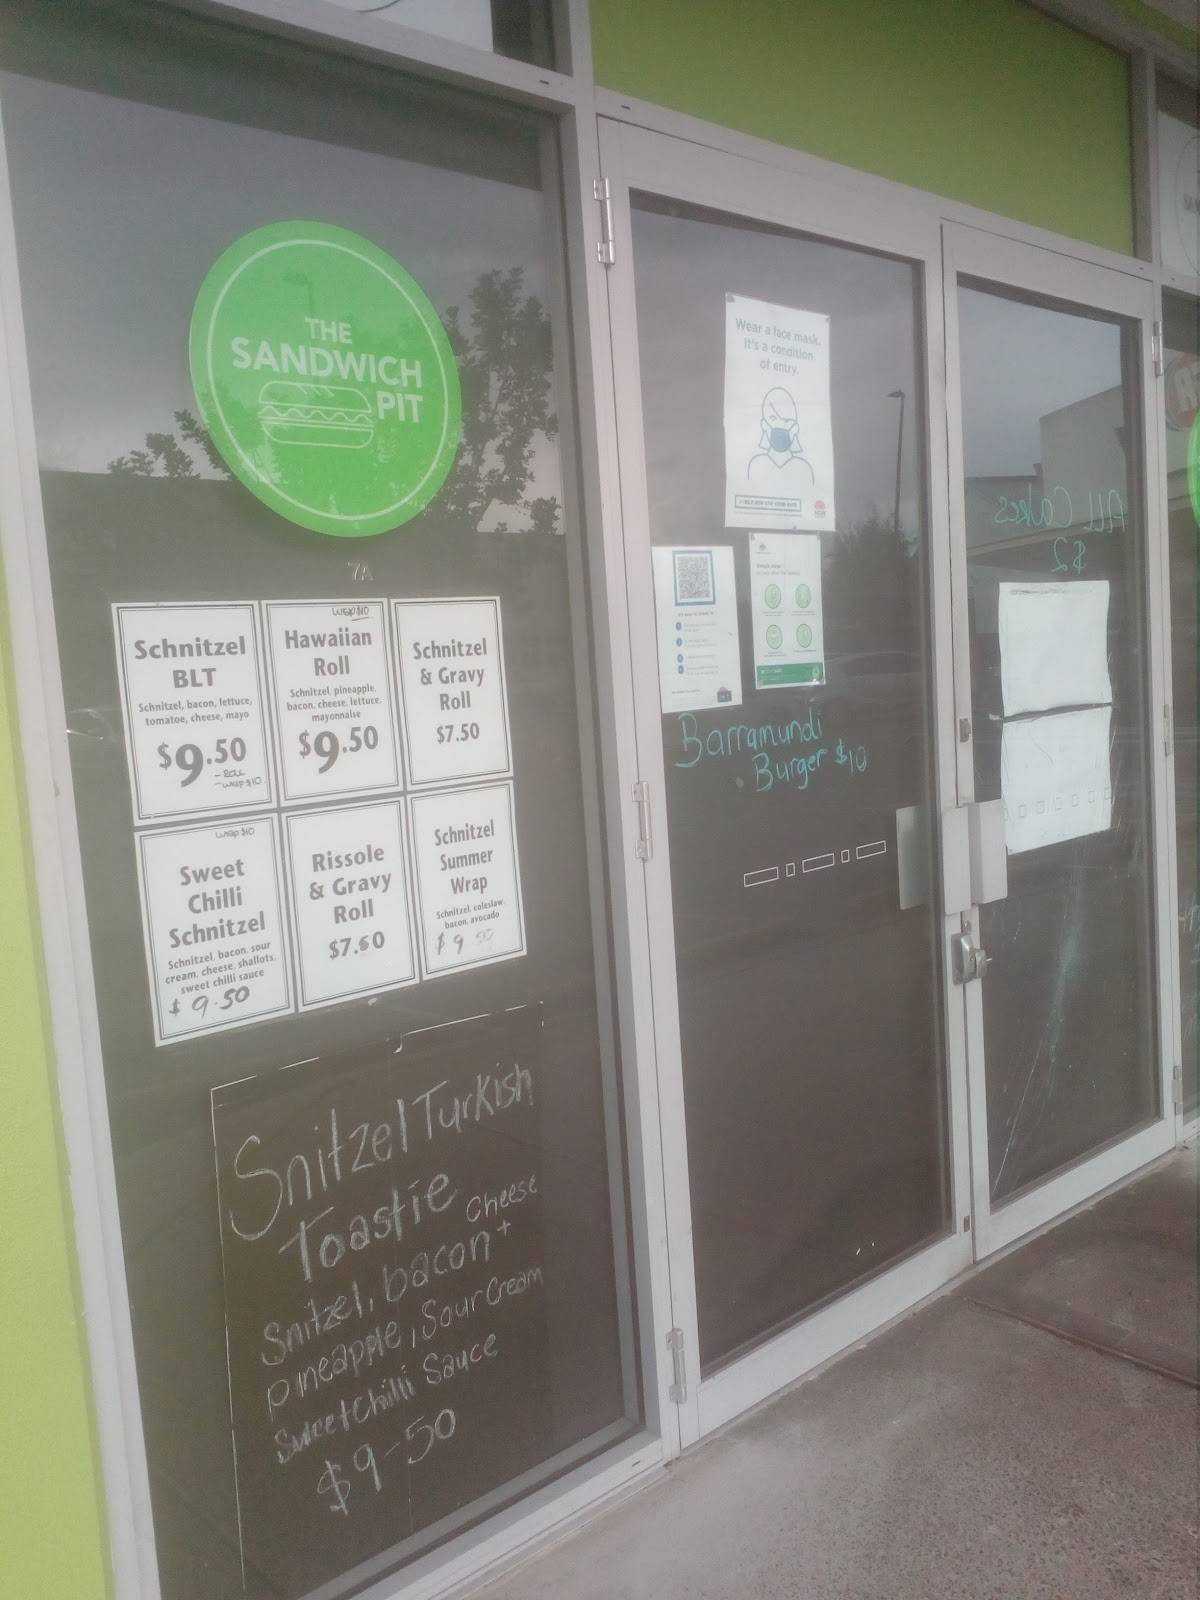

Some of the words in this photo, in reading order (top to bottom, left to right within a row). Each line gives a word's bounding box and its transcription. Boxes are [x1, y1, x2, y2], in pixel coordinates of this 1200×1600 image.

[305, 317, 352, 344] THE
[736, 318, 761, 333] Wear
[765, 326, 771, 336] a
[762, 343, 768, 352] a
[231, 337, 422, 388] SANDWICH
[760, 358, 771, 369] of
[376, 391, 423, 422] PIT
[134, 636, 246, 660] Schnitzel
[284, 628, 372, 649] Hawaiian
[413, 638, 487, 660] Schnitzel
[172, 668, 216, 688] BLT
[313, 656, 350, 676] Roll
[420, 668, 432, 685] &
[438, 667, 485, 687] Gravy
[334, 683, 377, 697] pineapple,
[440, 691, 471, 711] Roll
[138, 699, 184, 713] Schnitzel,
[187, 699, 217, 709] bacon,
[219, 697, 253, 706] lettuce,
[287, 702, 315, 711] bacon,
[312, 709, 361, 723] mayonnaise
[145, 715, 188, 727] tomatoe,
[190, 713, 223, 722] cheese,
[226, 711, 249, 721] mayo
[437, 722, 480, 744] $7.50
[674, 706, 823, 768] Barramundi
[298, 725, 379, 774] $9.50
[157, 737, 247, 788] $9.50
[752, 749, 828, 792] Burger
[834, 738, 867, 776] $10
[434, 819, 495, 846] Schnitzel
[312, 844, 385, 872] Rissole
[440, 850, 493, 871] Summer
[180, 858, 245, 886] Sweet
[309, 882, 325, 901] &
[333, 873, 392, 897] Gravy
[451, 876, 488, 894] Wrap
[188, 886, 243, 914] Chilli
[333, 899, 374, 924] Roll
[470, 911, 500, 924] avocado
[169, 911, 266, 949] Schnitzel
[168, 952, 216, 970] Schnitzel,
[218, 947, 248, 959] bacon,
[251, 942, 271, 953] sour
[165, 971, 199, 984] cream,
[201, 963, 236, 976] cheese,
[181, 980, 210, 994] sweet
[213, 973, 236, 987] chilli
[239, 969, 265, 981] sauce
[229, 1098, 408, 1241] Snitzel
[278, 1173, 458, 1283] Toastie
[383, 1231, 491, 1302] bacon
[497, 1220, 511, 1236] +
